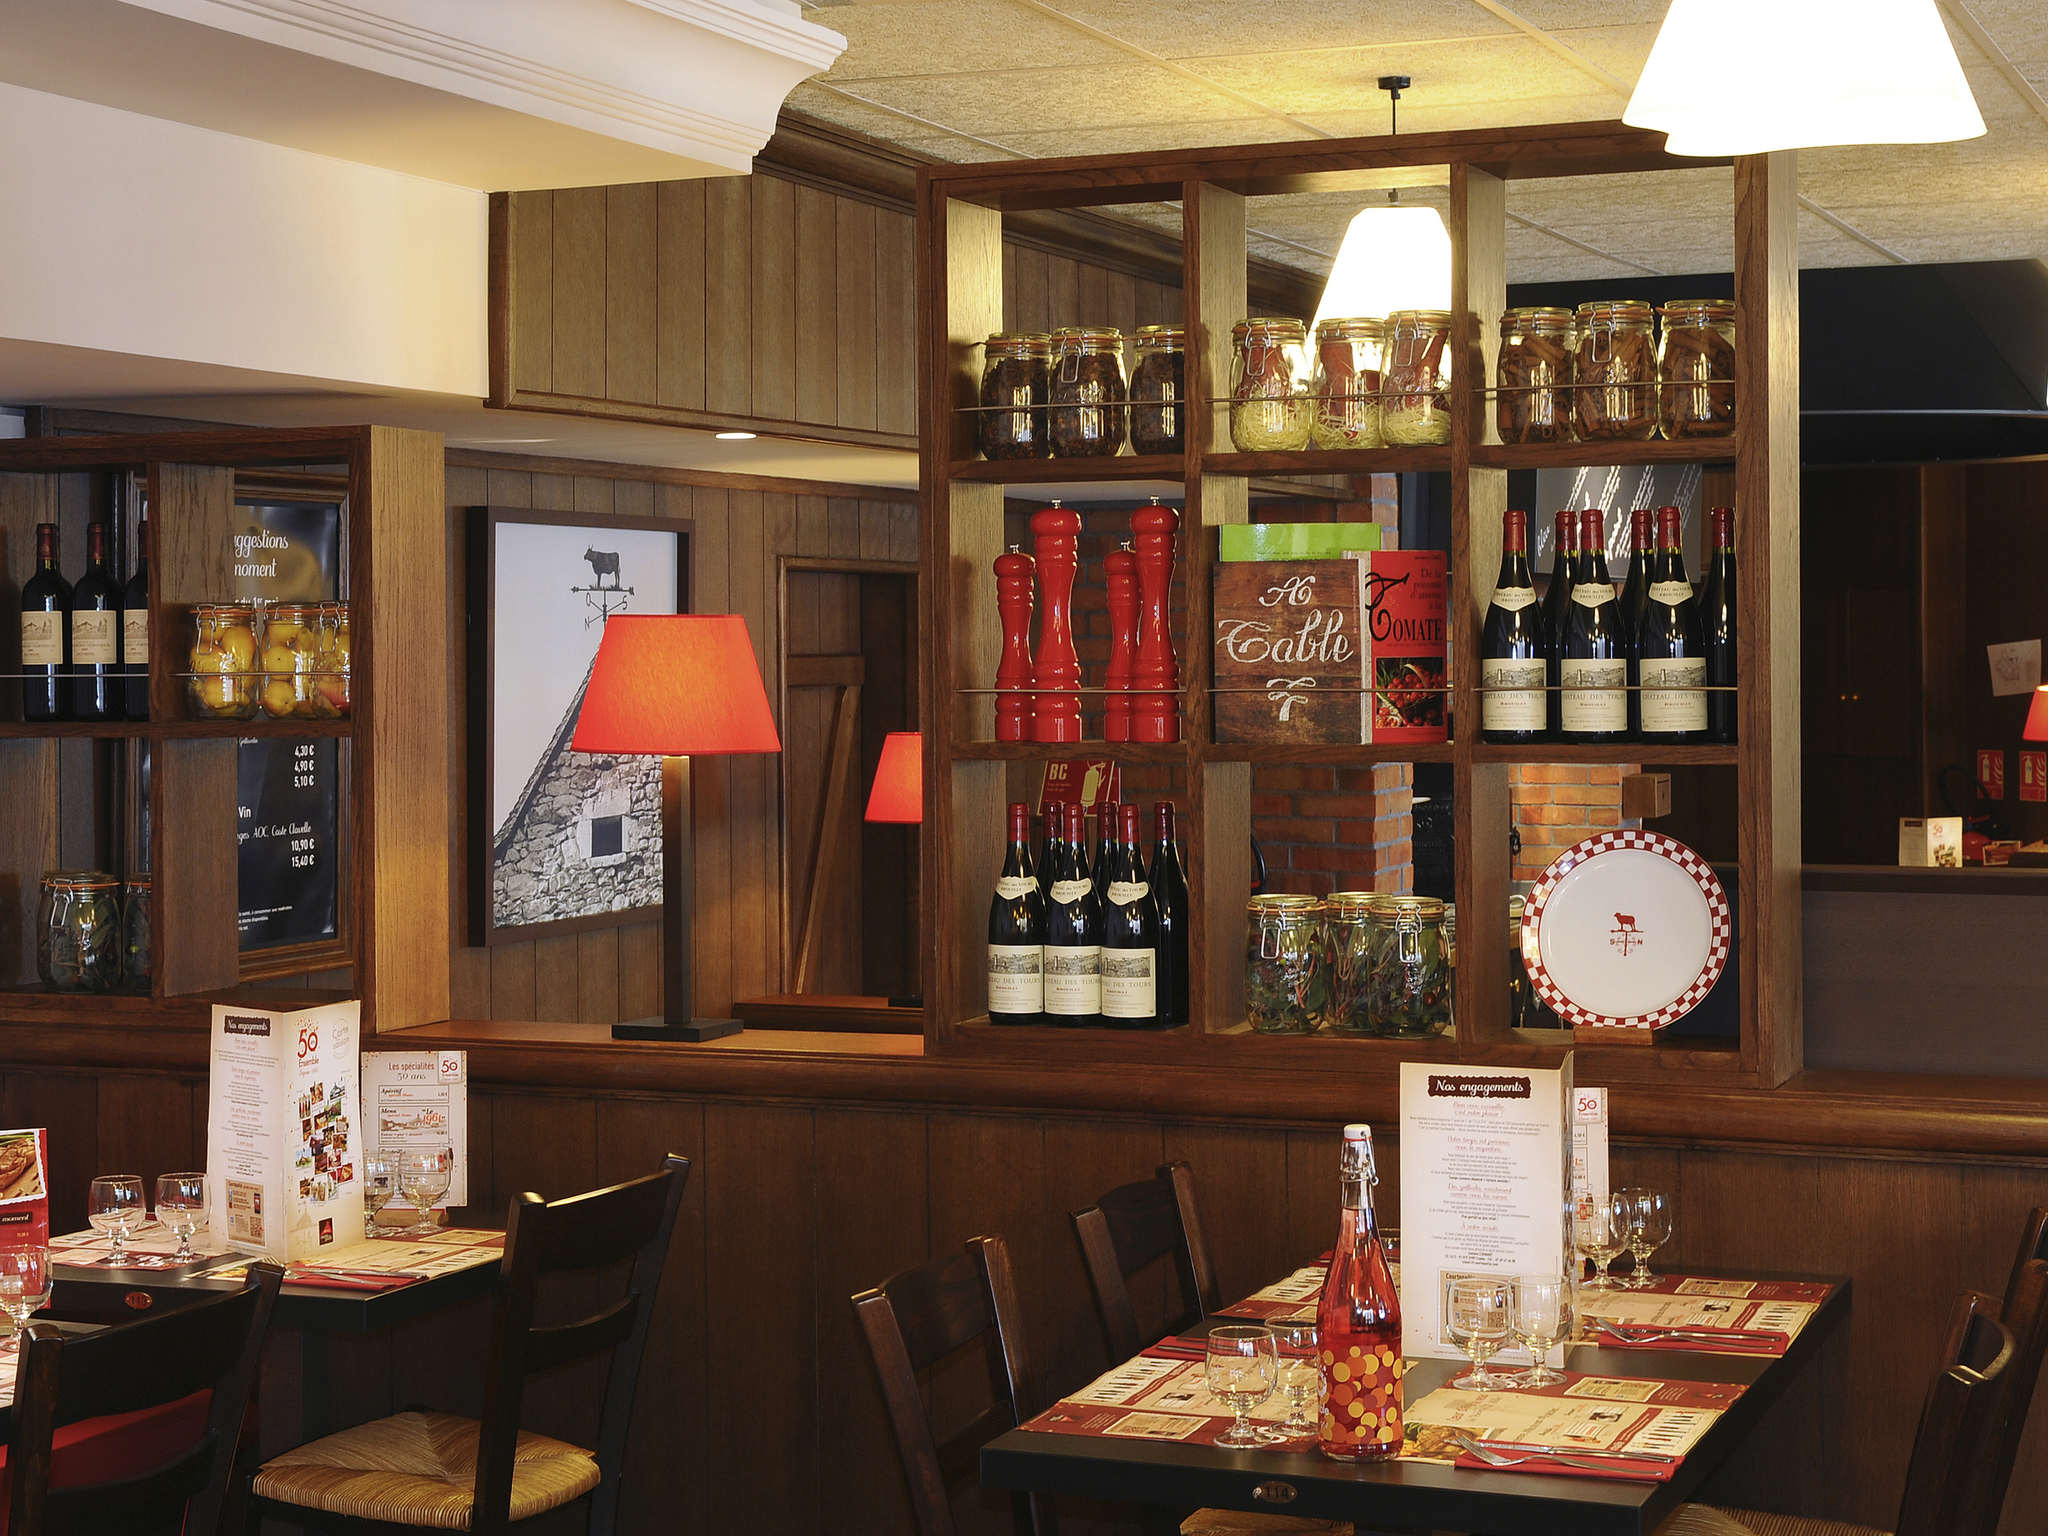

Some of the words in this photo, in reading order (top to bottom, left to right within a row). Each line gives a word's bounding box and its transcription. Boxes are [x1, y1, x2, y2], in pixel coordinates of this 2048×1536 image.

[1258, 575, 1316, 607] A
[1216, 608, 1355, 664] Table
[1049, 763, 1069, 780] BC
[297, 1028, 319, 1058] 50
[388, 1062, 400, 1071] Les
[401, 1061, 435, 1072] spécialités
[440, 1060, 458, 1073] 50
[1434, 1079, 1457, 1093] Nos
[1459, 1081, 1525, 1096] engagements
[1577, 1097, 1598, 1112] 50
